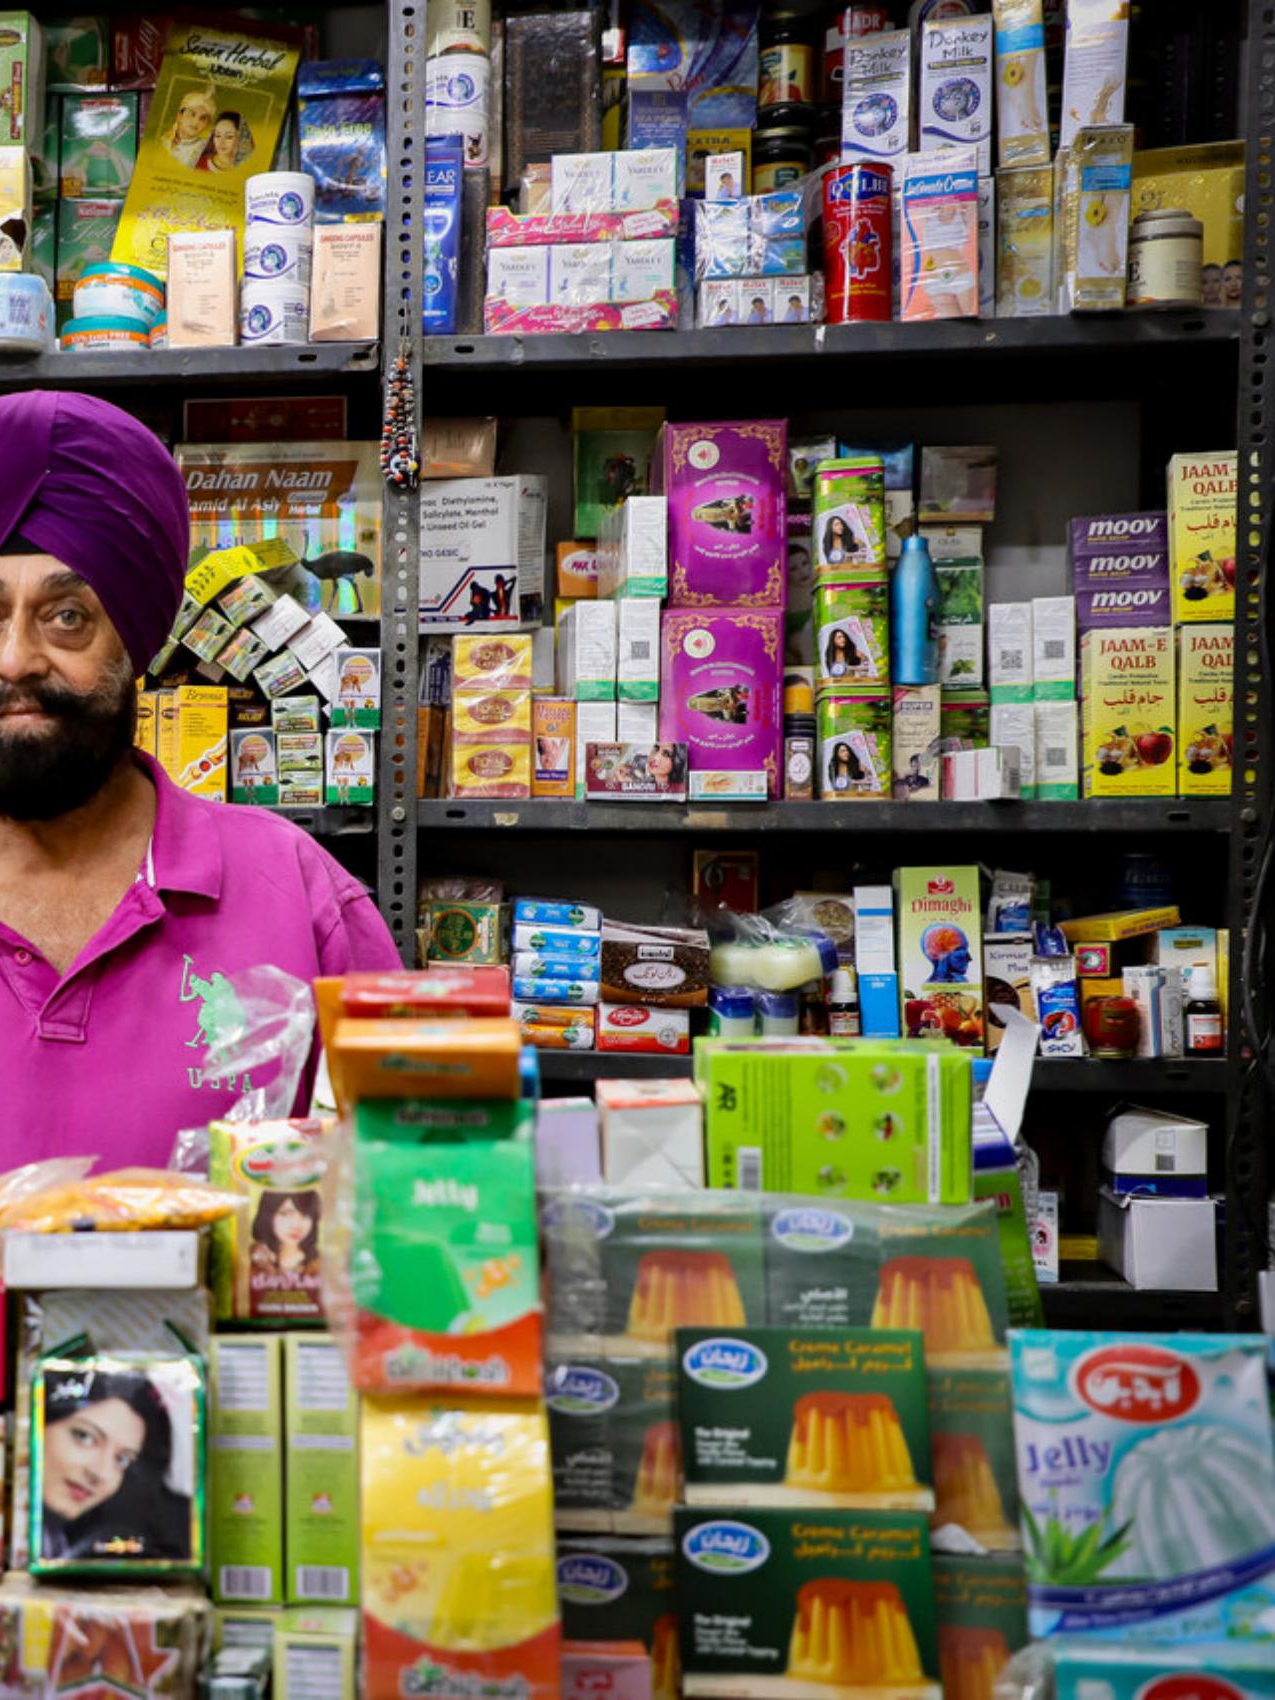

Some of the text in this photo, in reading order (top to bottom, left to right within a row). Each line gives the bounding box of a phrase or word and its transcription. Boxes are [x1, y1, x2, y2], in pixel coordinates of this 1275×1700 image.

[928, 31, 988, 49] Donkey
[225, 42, 286, 72] Herbal
[943, 46, 974, 60] Milk
[427, 169, 456, 185] EAR
[627, 165, 665, 175] YARDLEY
[499, 263, 537, 272] YARDLEY
[626, 256, 663, 266] YARDLEY
[188, 469, 333, 490] Dahan Naam
[189, 497, 229, 512] amid
[1088, 518, 1159, 536] moov
[1089, 554, 1160, 572] moov
[1091, 589, 1162, 608] moov
[1100, 638, 1168, 655] JAAM-E
[1110, 655, 1157, 673] QALB
[911, 897, 973, 915] Dimaghi
[1025, 1436, 1113, 1476] Jelly
